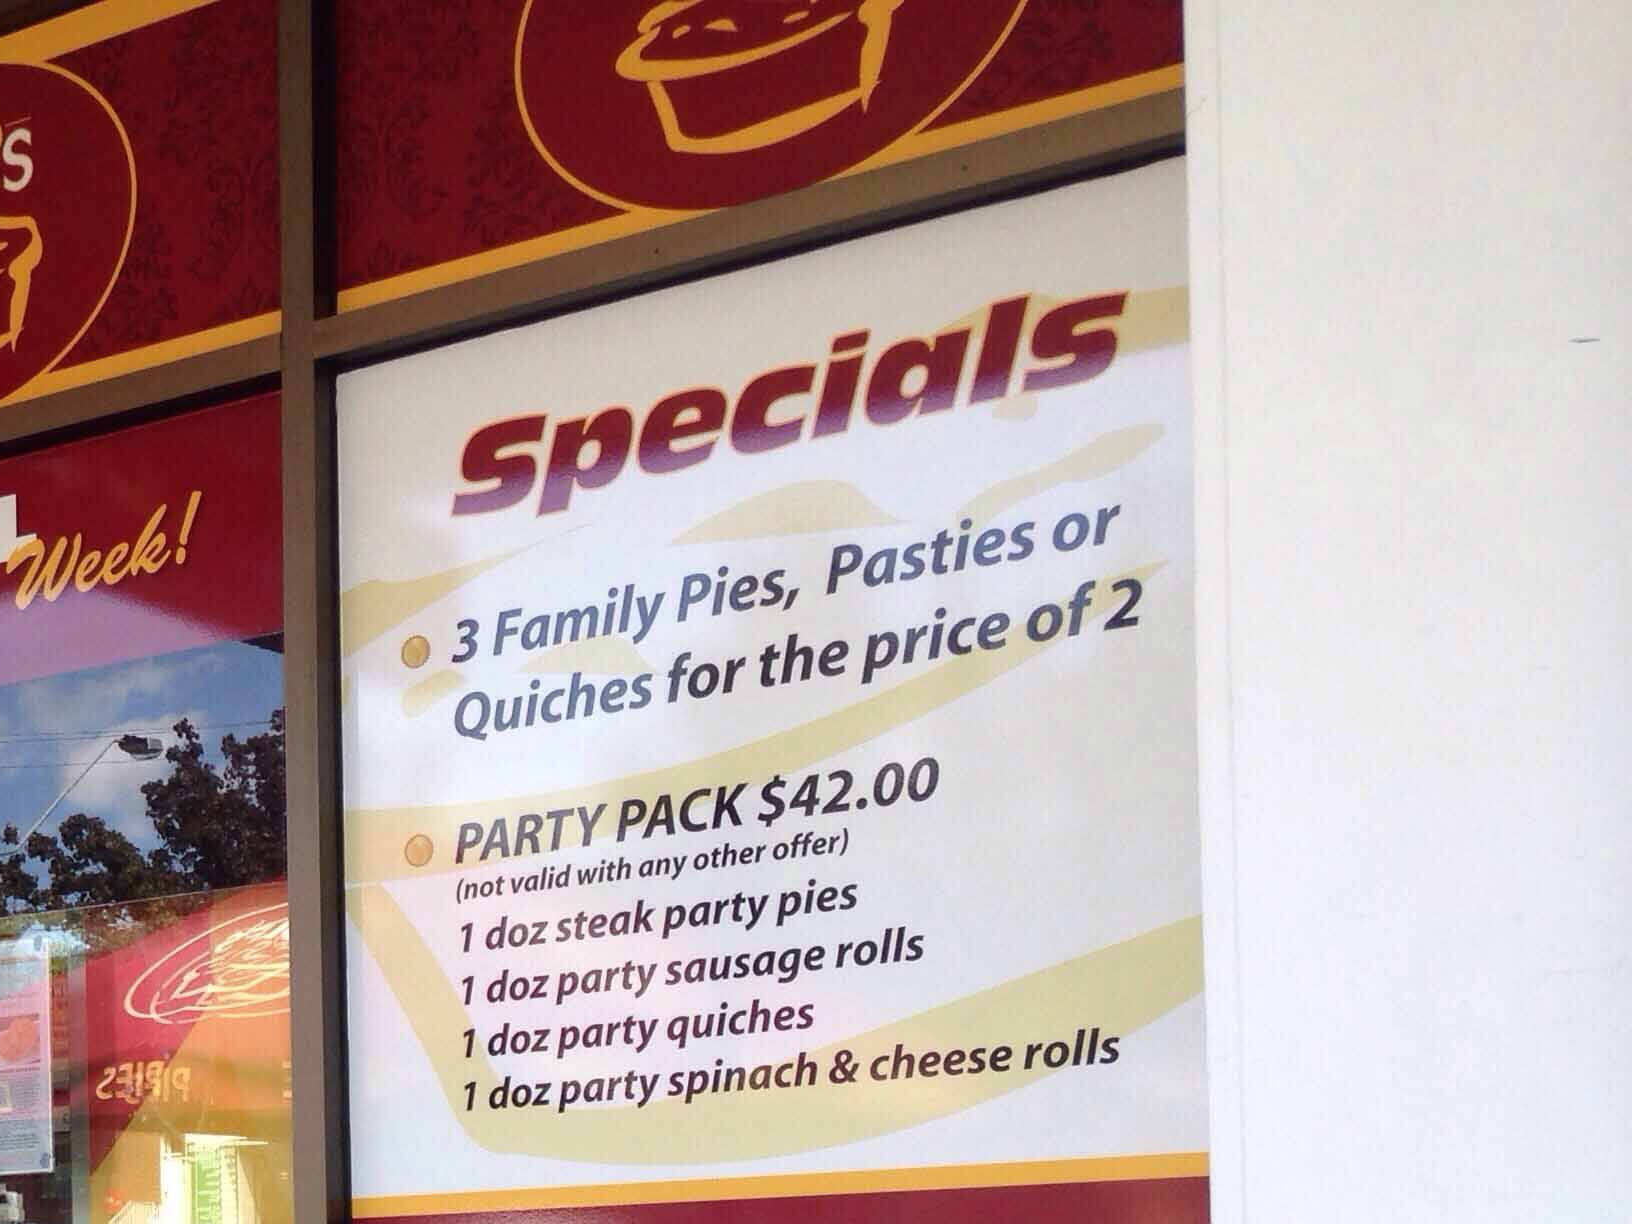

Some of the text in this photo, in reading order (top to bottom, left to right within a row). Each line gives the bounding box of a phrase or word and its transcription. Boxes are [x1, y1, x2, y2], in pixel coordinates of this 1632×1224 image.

[6, 491, 202, 610] Week!
[450, 503, 1121, 664] 3 Family Pies, Pasties or
[453, 578, 1144, 741] Quiches for the price of 2
[454, 757, 940, 864] PARTY PACK $42.00
[455, 828, 850, 904] (not valid with any other offer)
[459, 880, 859, 953] 1 doz steak party pies
[460, 926, 925, 1006] 1 doz party sausage rolls
[461, 997, 816, 1060] 1 doz party quiches
[464, 1026, 1121, 1114] 1 doz party spinach & cheese rolls
